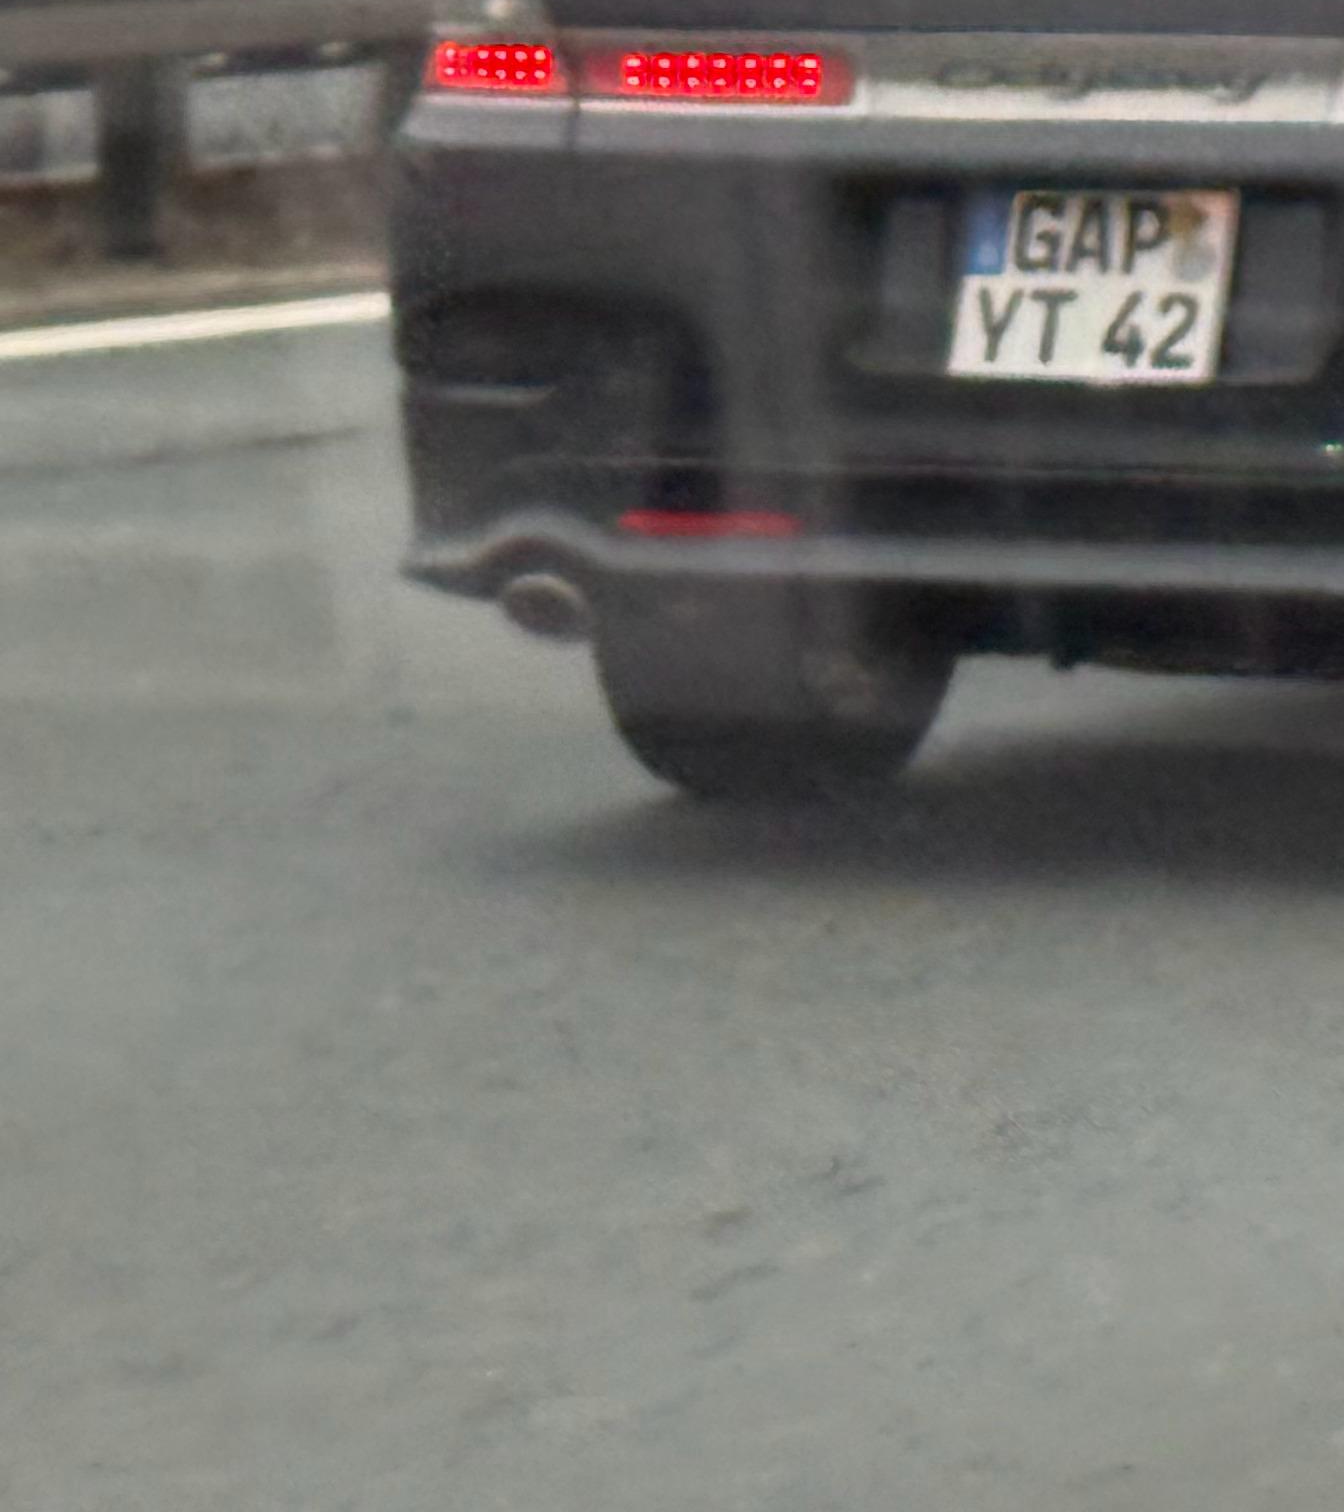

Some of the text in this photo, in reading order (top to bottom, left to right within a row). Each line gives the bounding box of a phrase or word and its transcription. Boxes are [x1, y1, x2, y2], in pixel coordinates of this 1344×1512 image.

[1013, 194, 1170, 274] GAP
[977, 286, 1199, 370] YT 42
